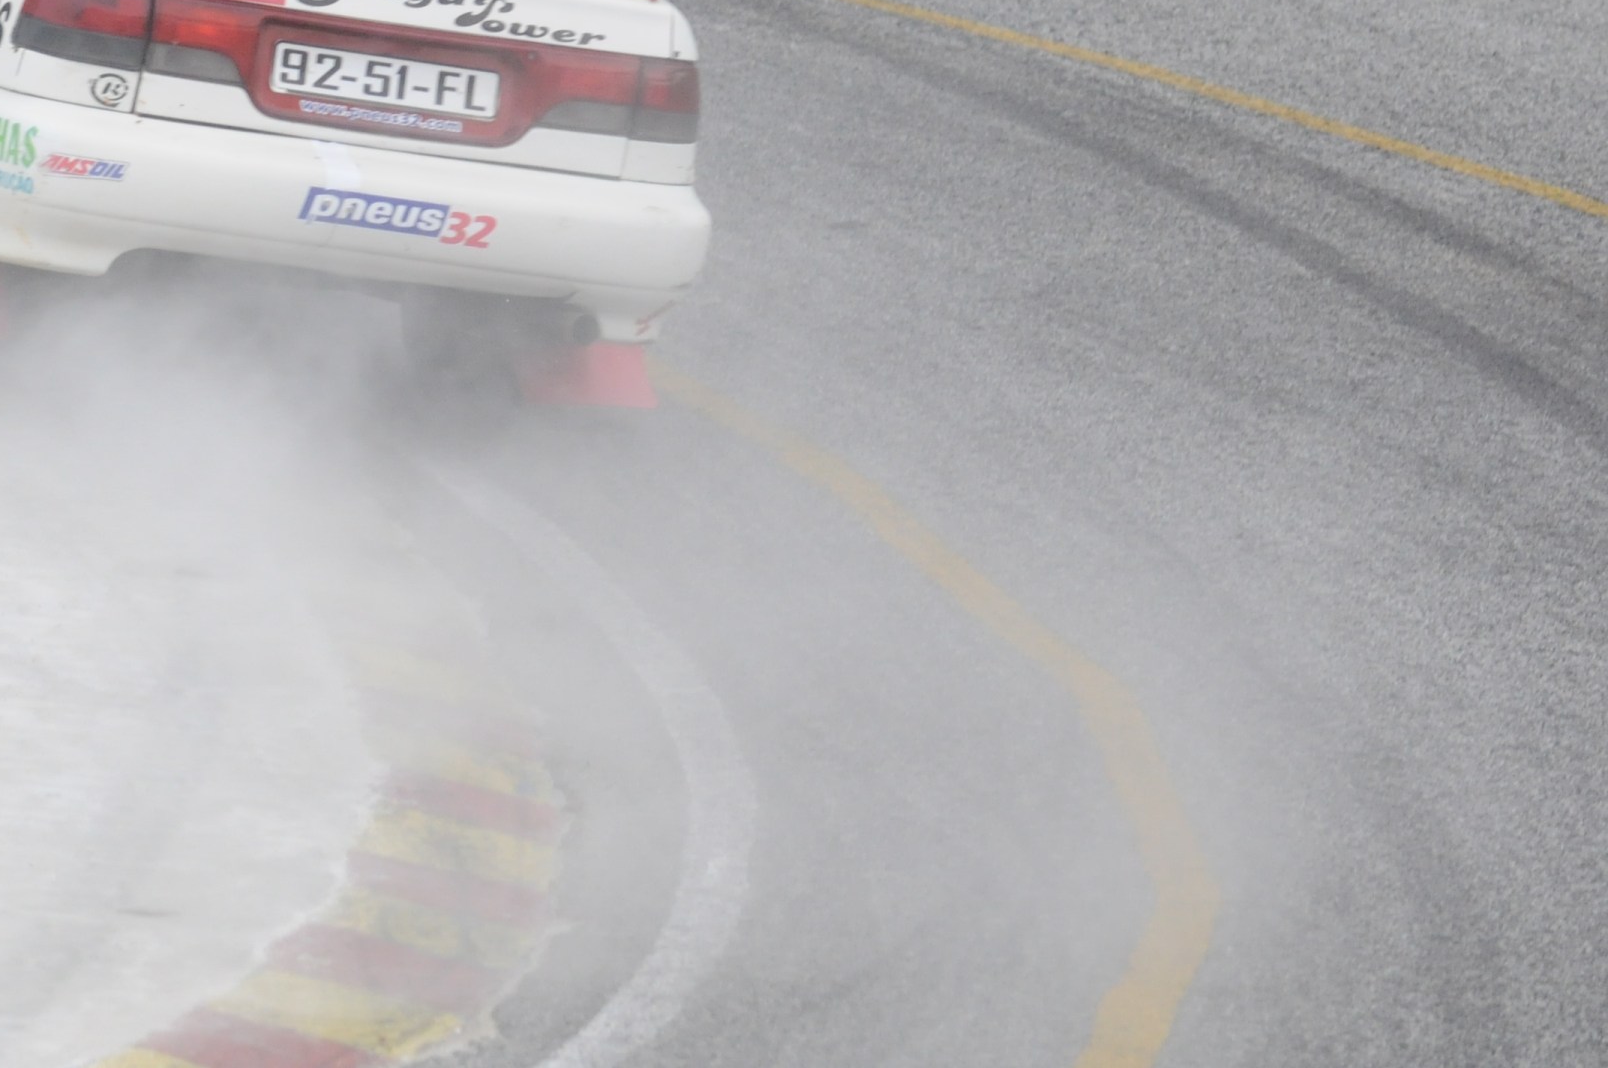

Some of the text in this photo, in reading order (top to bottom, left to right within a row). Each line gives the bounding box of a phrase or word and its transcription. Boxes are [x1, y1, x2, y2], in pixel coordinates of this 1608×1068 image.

[279, 47, 487, 113] 92-51-FL
[40, 154, 130, 179] AMSOIL
[305, 192, 497, 250] pneus32
